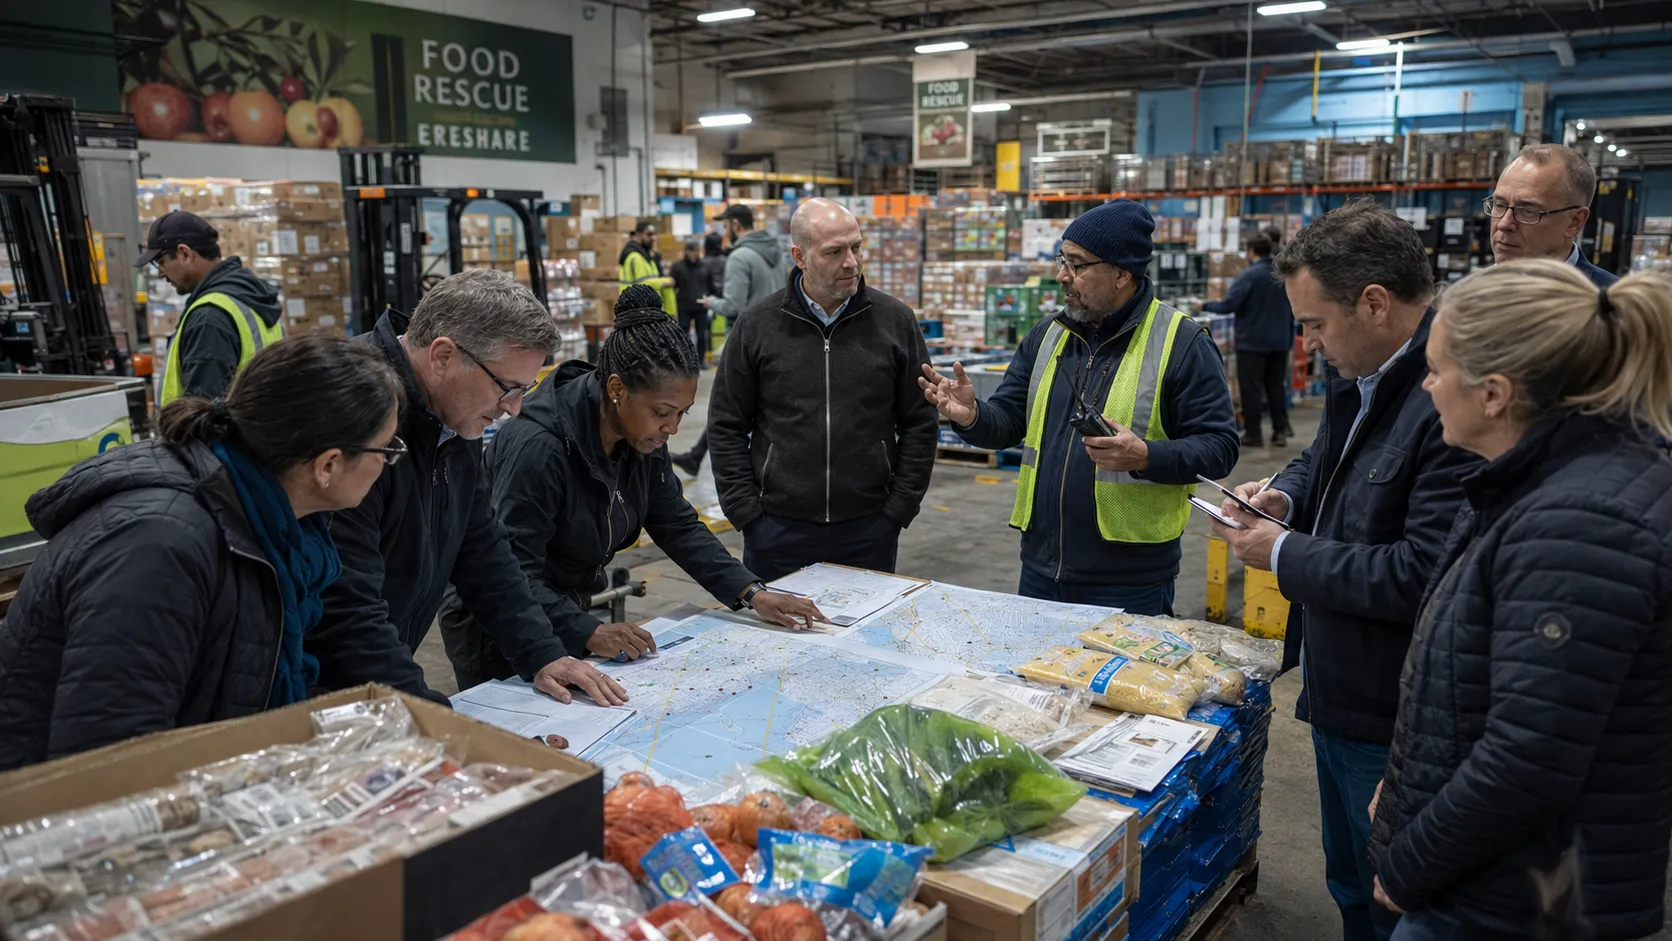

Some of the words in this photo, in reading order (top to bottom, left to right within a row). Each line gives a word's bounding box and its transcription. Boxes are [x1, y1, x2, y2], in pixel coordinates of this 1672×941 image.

[422, 39, 520, 79] FOOD
[414, 74, 530, 112] RESCUE
[417, 123, 531, 152] ERESHARE
